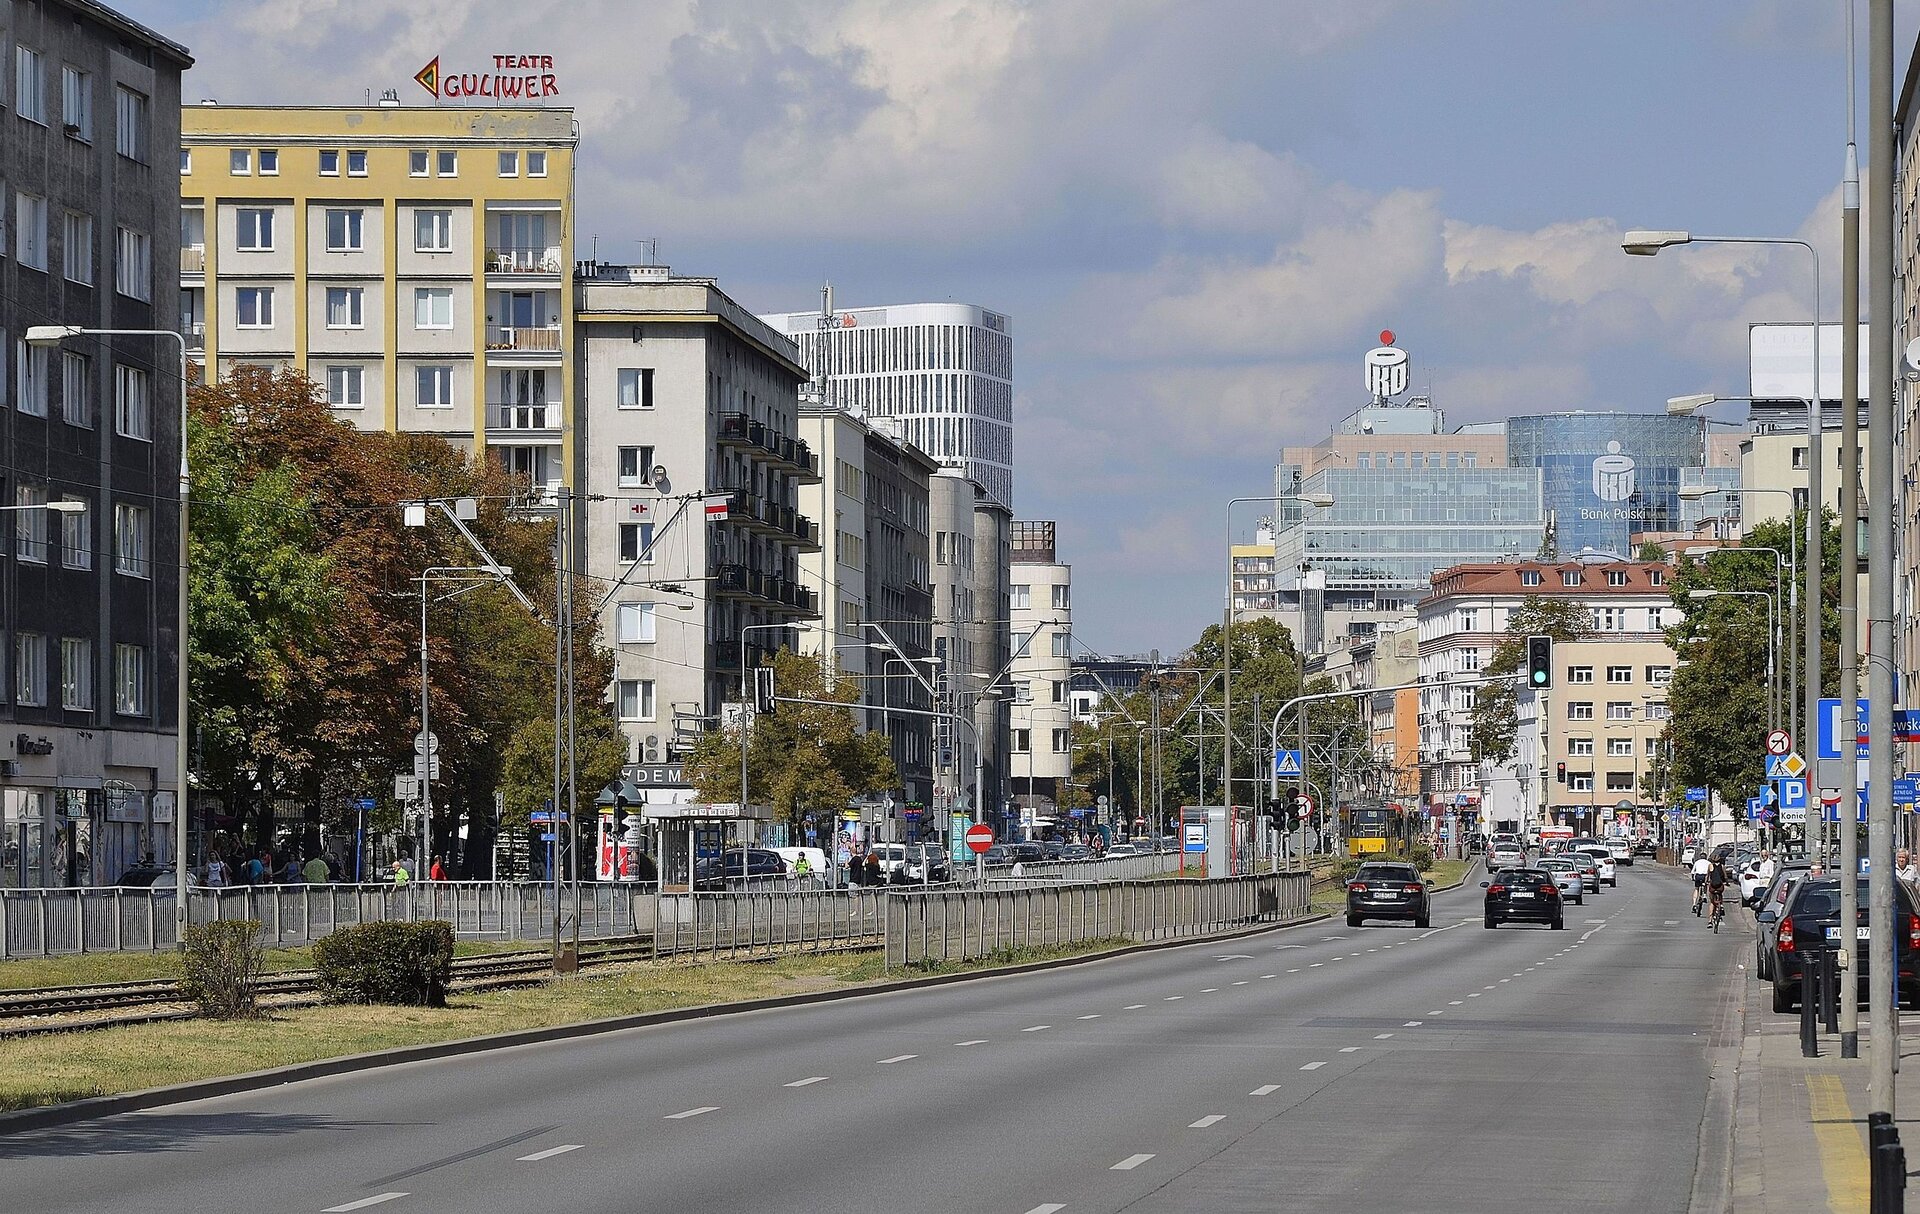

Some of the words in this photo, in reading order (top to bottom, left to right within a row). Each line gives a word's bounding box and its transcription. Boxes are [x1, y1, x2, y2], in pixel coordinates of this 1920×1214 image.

[493, 55, 553, 69] TEATR
[443, 73, 559, 99] GULIWER
[1581, 508, 1610, 520] Bank
[1614, 508, 1646, 520] Polski
[1786, 781, 1803, 804] P
